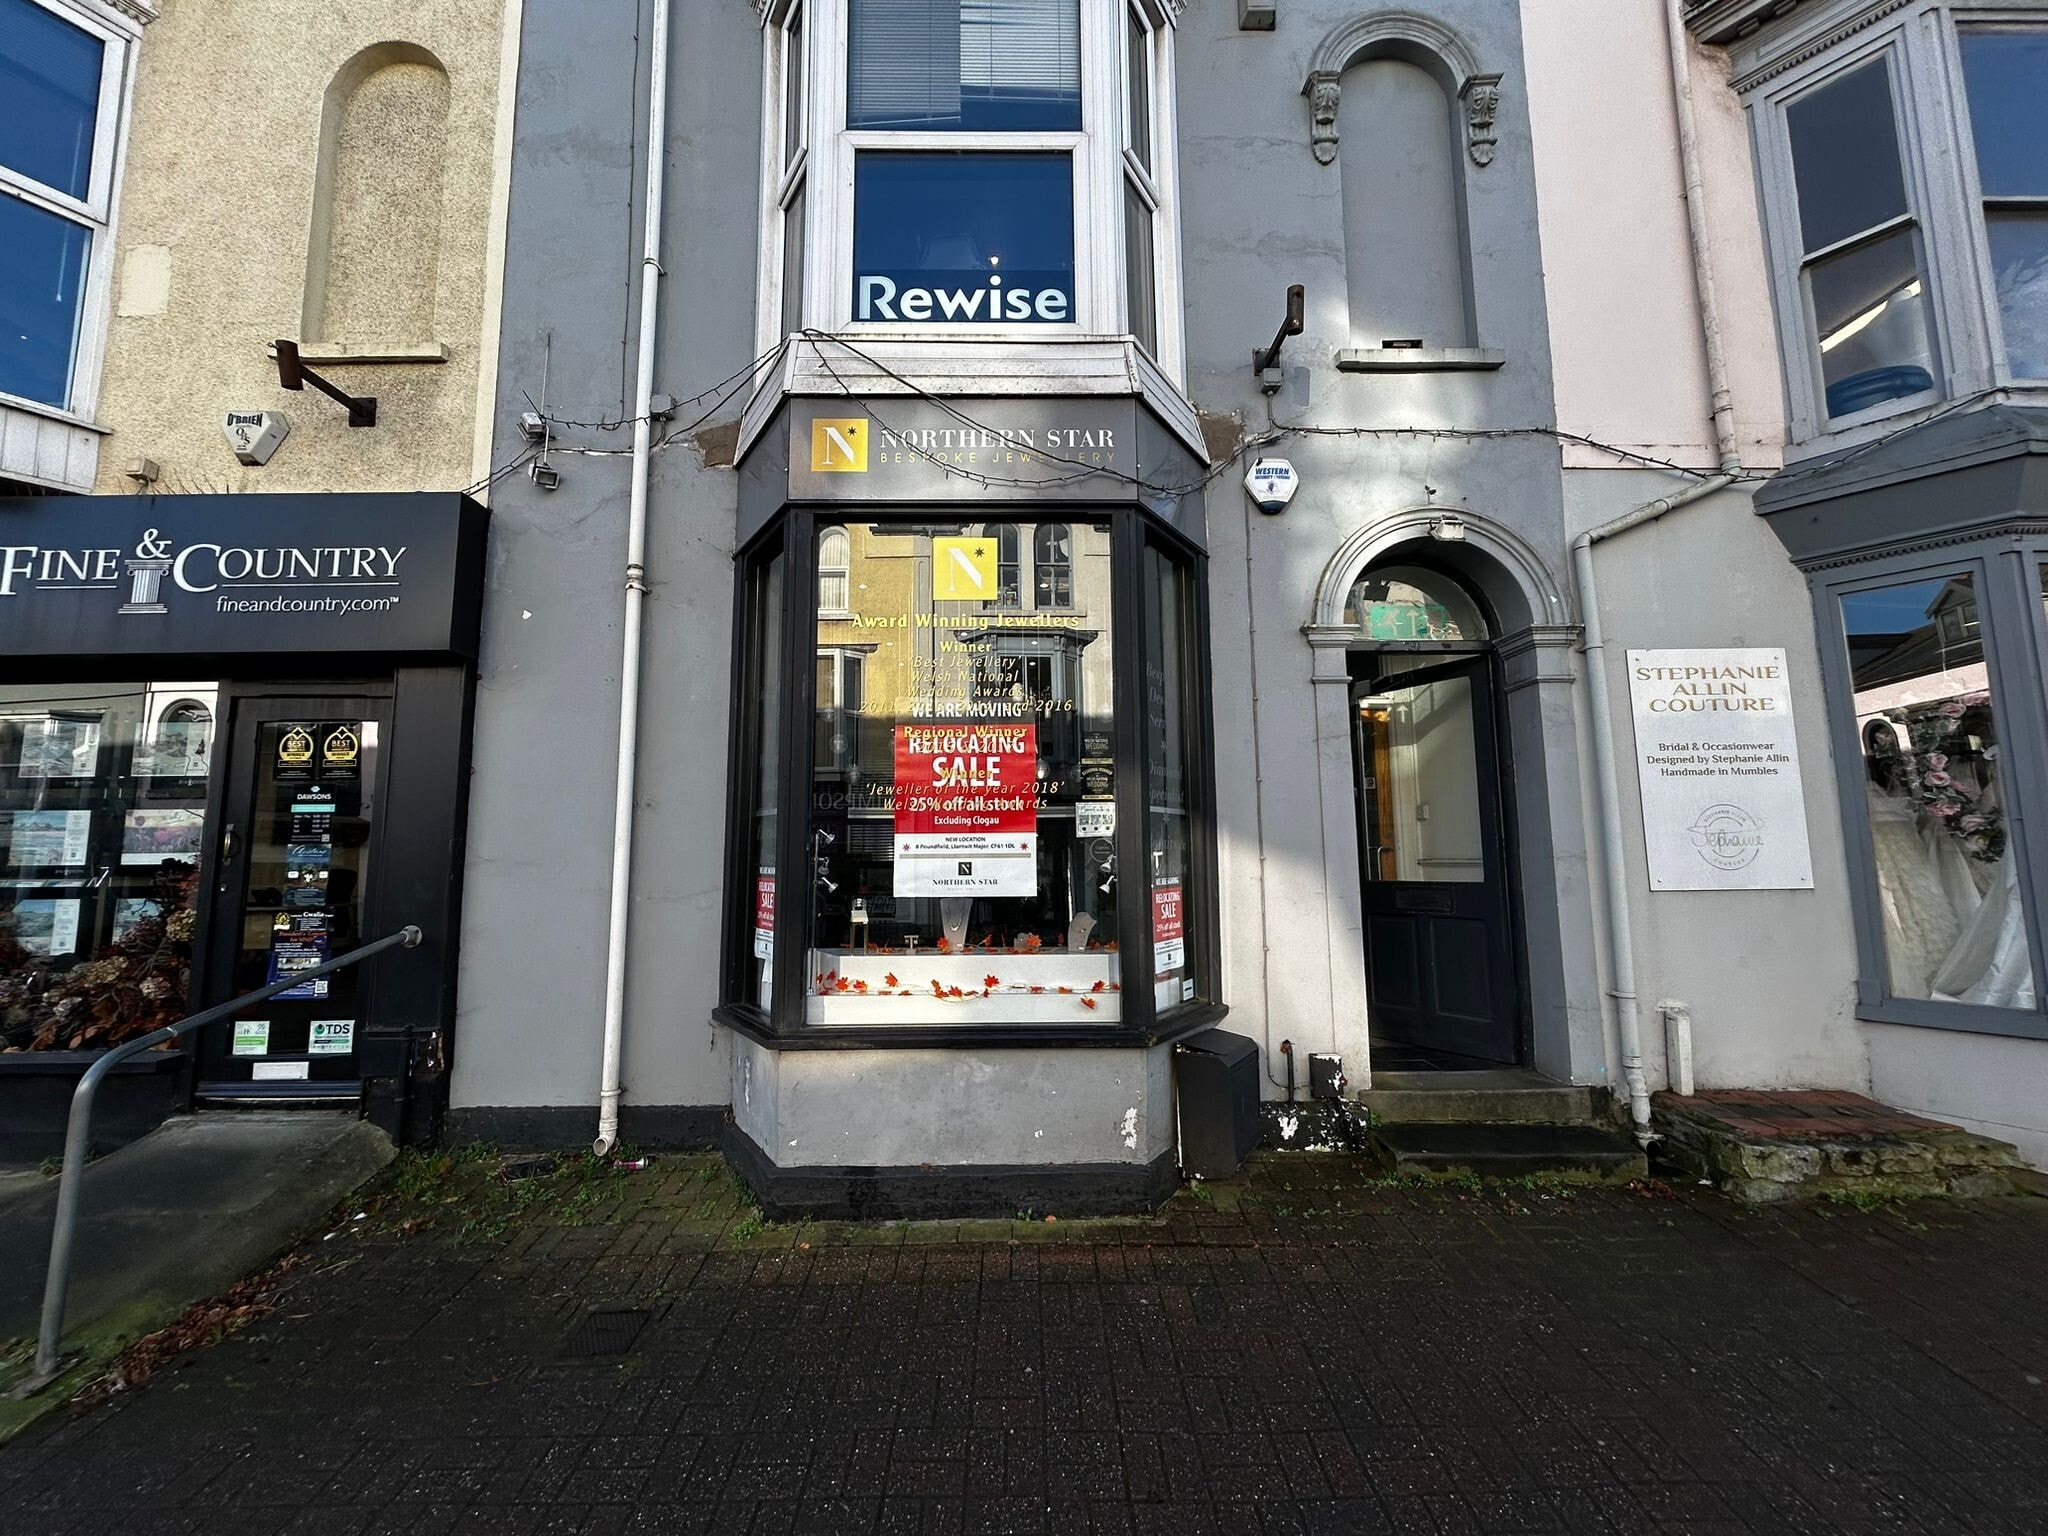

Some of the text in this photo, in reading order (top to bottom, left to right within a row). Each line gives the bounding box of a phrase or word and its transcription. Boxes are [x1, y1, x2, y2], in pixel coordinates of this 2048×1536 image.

[858, 274, 1068, 320] Rewise
[227, 413, 263, 427] O'BRIEN
[822, 426, 855, 465] N
[880, 428, 1116, 448] NORTHERN STAR
[880, 451, 1116, 464] BESPOKE JEWELLERY
[1255, 467, 1290, 475] WESTERN
[0, 528, 408, 595] FINE & COUNTRY
[948, 546, 984, 593] N
[851, 612, 1080, 631] Award Winning Jewellers
[939, 641, 993, 654] Winner
[911, 669, 1019, 683] Welsh National
[1636, 666, 1781, 682] STEPHANIE
[907, 685, 967, 700] Wedding
[1672, 681, 1747, 696] ALLIN
[912, 702, 1022, 718] WE ARE MOVING
[1035, 699, 1073, 712] 2016
[1648, 697, 1775, 713] COUTURE
[903, 725, 1028, 741] Regional Winner
[286, 740, 306, 748] BEST
[331, 740, 350, 748] BEST
[908, 734, 1025, 754] RELOCATING
[1658, 742, 1775, 752] Bridal & Occasionwear
[1646, 754, 1790, 765] Designed by Stephanie Allin
[931, 756, 1001, 787] SALE
[939, 768, 993, 780] Winner
[1660, 766, 1778, 777] Handmade in Mumbles
[935, 784, 948, 795] of
[954, 783, 969, 795] the
[982, 784, 1015, 798] year
[909, 796, 1024, 812] 25% off all stock
[934, 815, 1000, 827] Excluding Clogau
[761, 893, 774, 909] SALE
[1161, 902, 1176, 920] SALE
[325, 1023, 350, 1035] TDS
